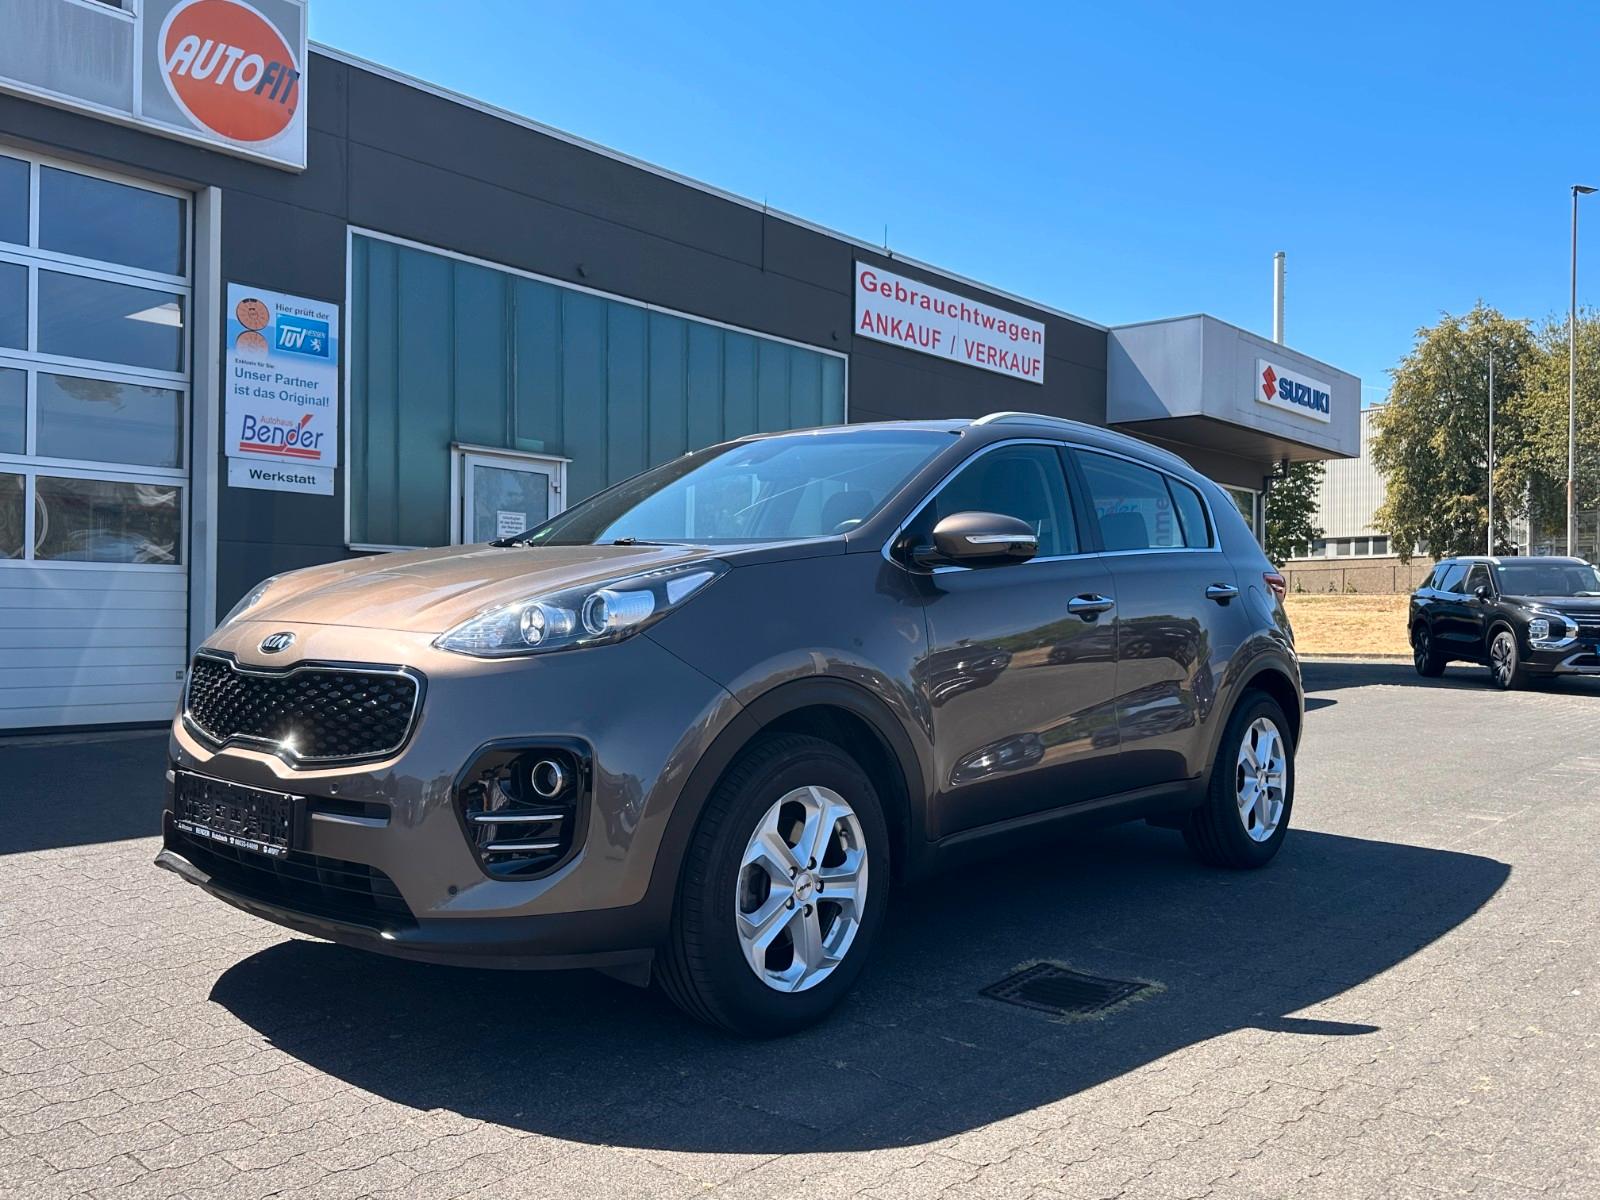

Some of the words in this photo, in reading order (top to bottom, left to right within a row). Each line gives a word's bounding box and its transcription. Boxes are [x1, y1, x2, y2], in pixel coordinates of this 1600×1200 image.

[275, 303, 292, 313] Hier
[294, 307, 314, 317] prüft
[316, 311, 329, 320] der
[860, 271, 1042, 344] Gebrauchtwagen
[860, 309, 942, 350] ANKAUF
[964, 338, 1041, 377] VERKAUF
[234, 367, 272, 382] Unser
[275, 373, 319, 389] Partner
[234, 383, 250, 396] ist
[253, 387, 276, 400] das
[279, 390, 330, 408] Original!
[1279, 377, 1330, 414] SUZUKI
[241, 414, 324, 449] Bender
[259, 415, 293, 427] Autohaus
[249, 468, 316, 485] Werkstatt
